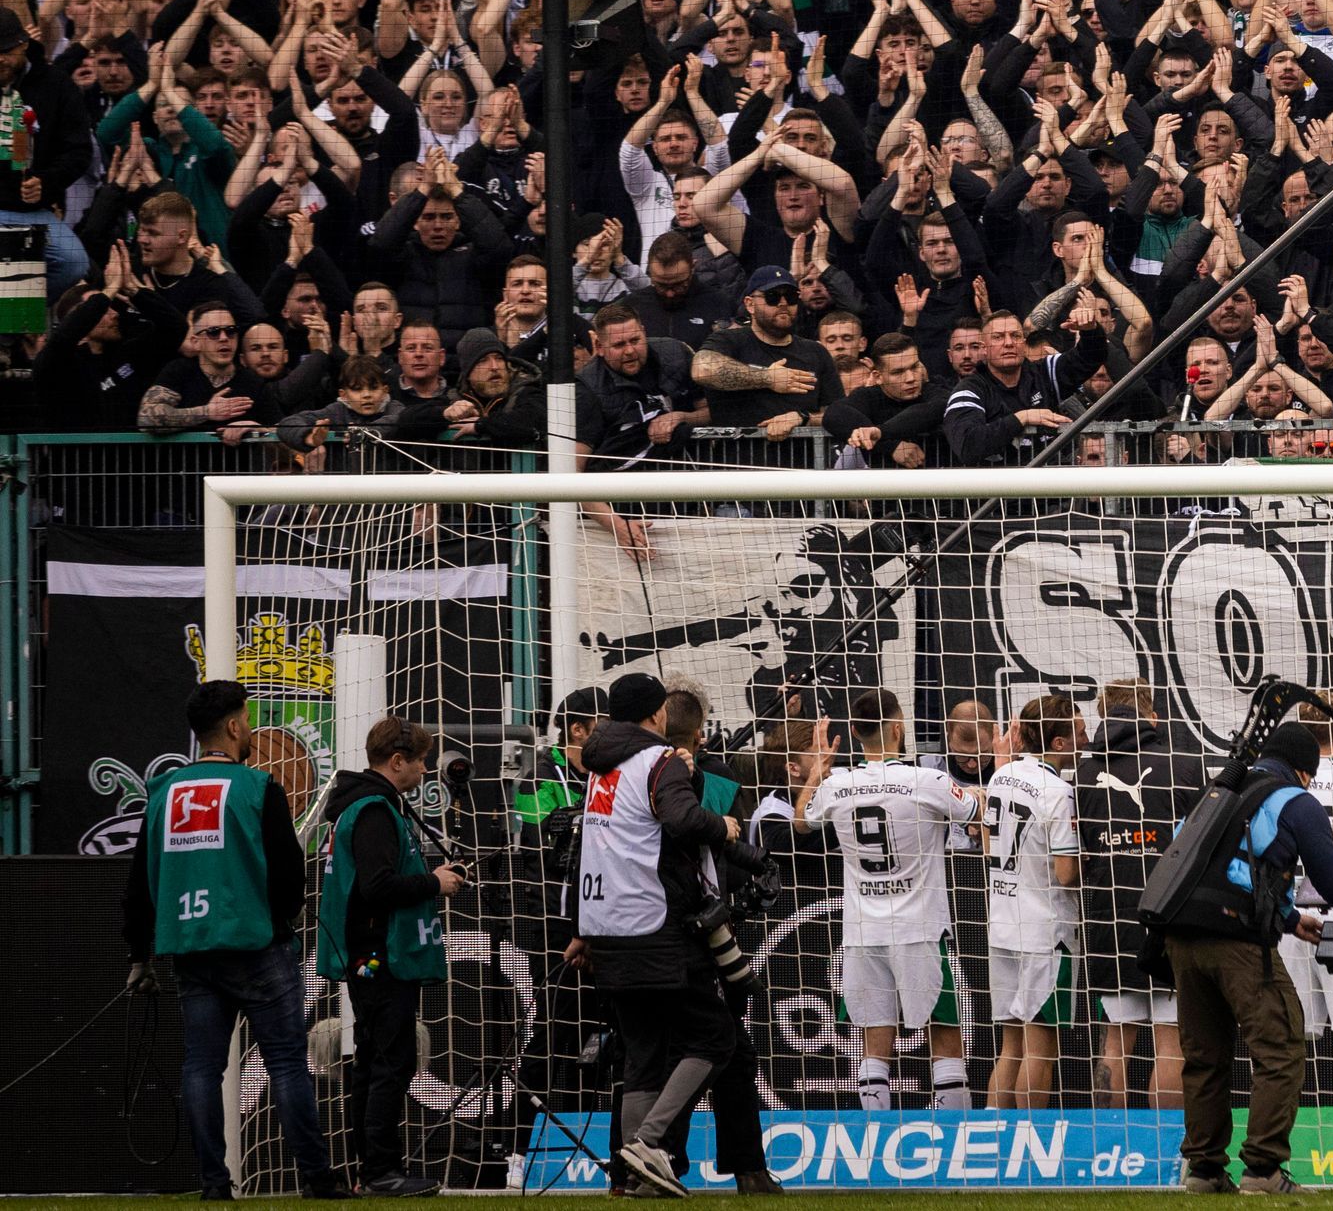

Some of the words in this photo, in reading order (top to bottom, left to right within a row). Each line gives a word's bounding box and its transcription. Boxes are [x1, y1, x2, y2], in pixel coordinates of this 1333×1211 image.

[169, 834, 220, 847] BUNDESLIGA
[852, 805, 901, 876] 9
[582, 872, 605, 902] 01
[857, 877, 914, 897] ONORAT
[178, 888, 210, 922] 15
